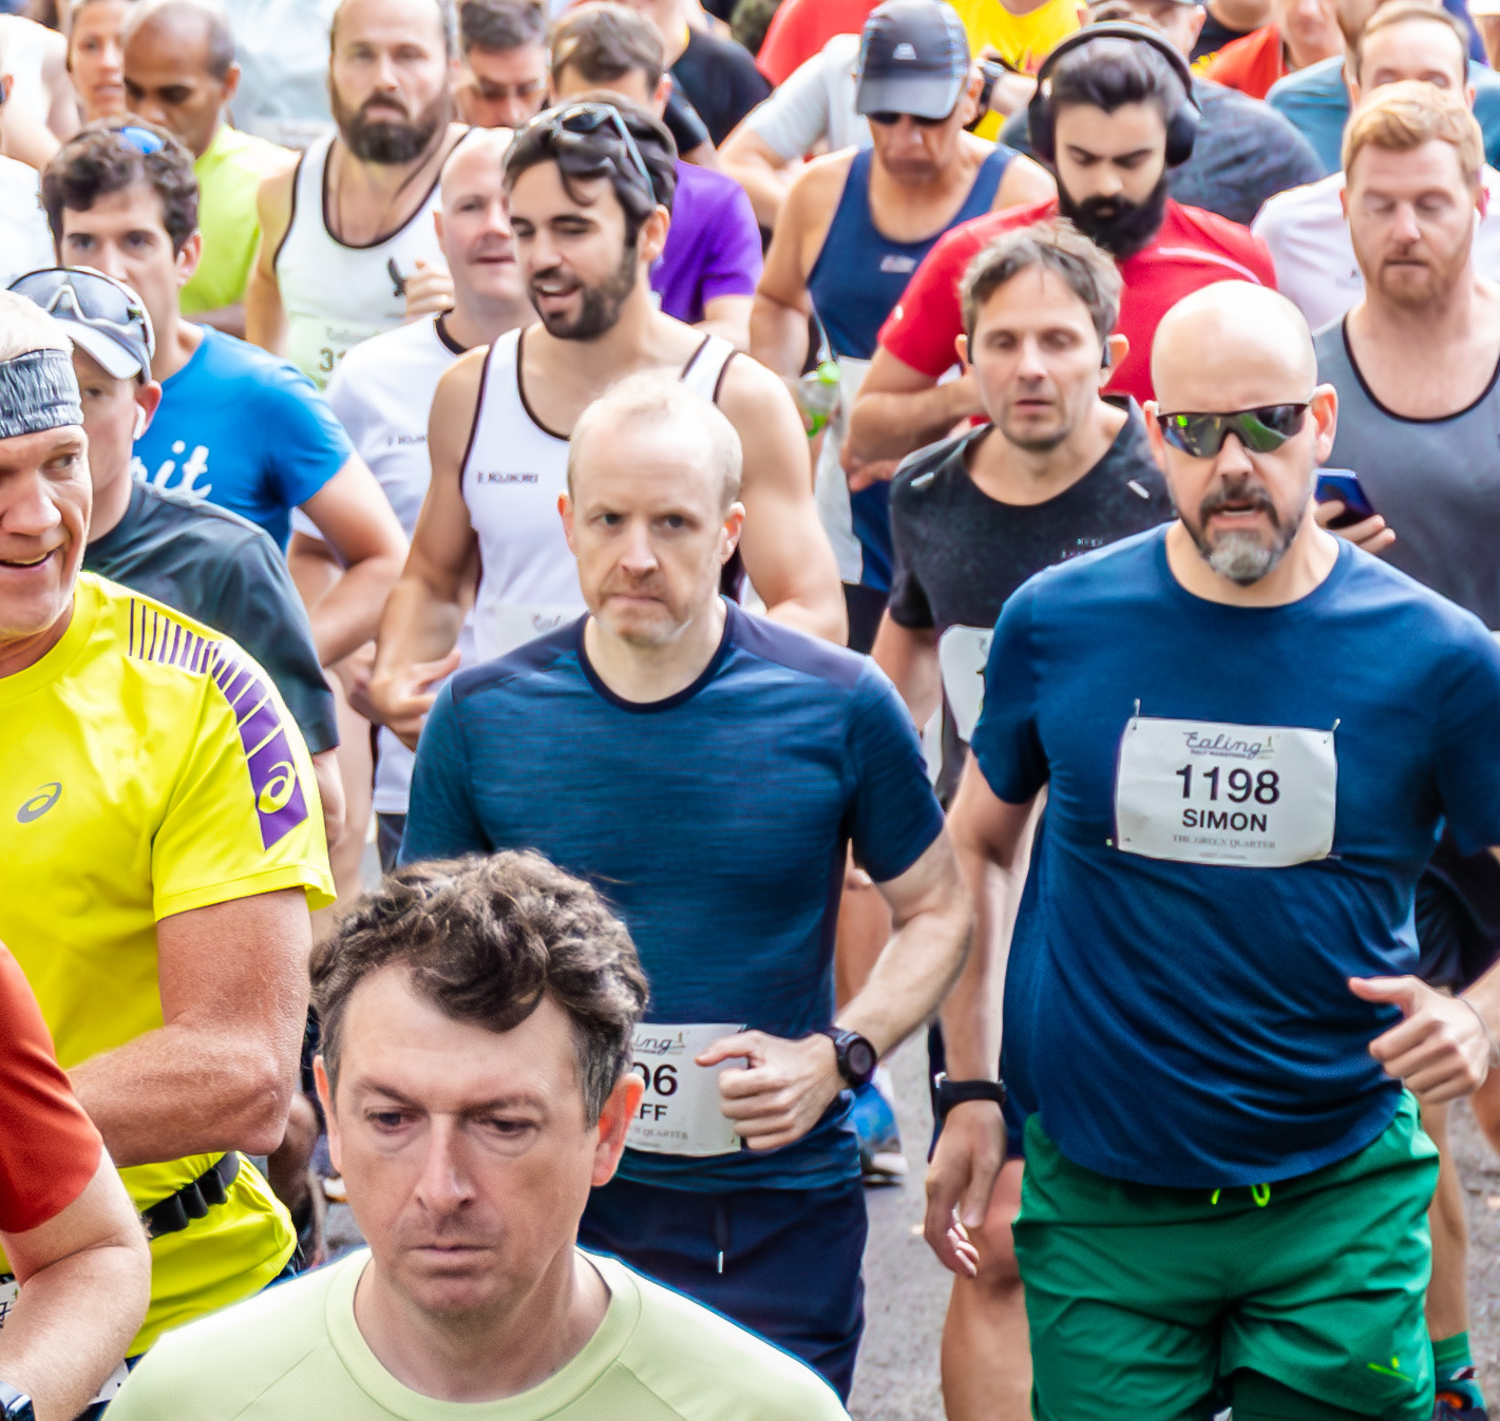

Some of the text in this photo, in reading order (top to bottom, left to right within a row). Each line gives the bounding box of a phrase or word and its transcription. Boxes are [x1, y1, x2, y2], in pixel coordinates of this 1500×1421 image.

[1183, 731, 1266, 760] Ealing
[1175, 764, 1280, 805] 1198
[1182, 808, 1267, 832] SIMON
[634, 1103, 668, 1121] FF
